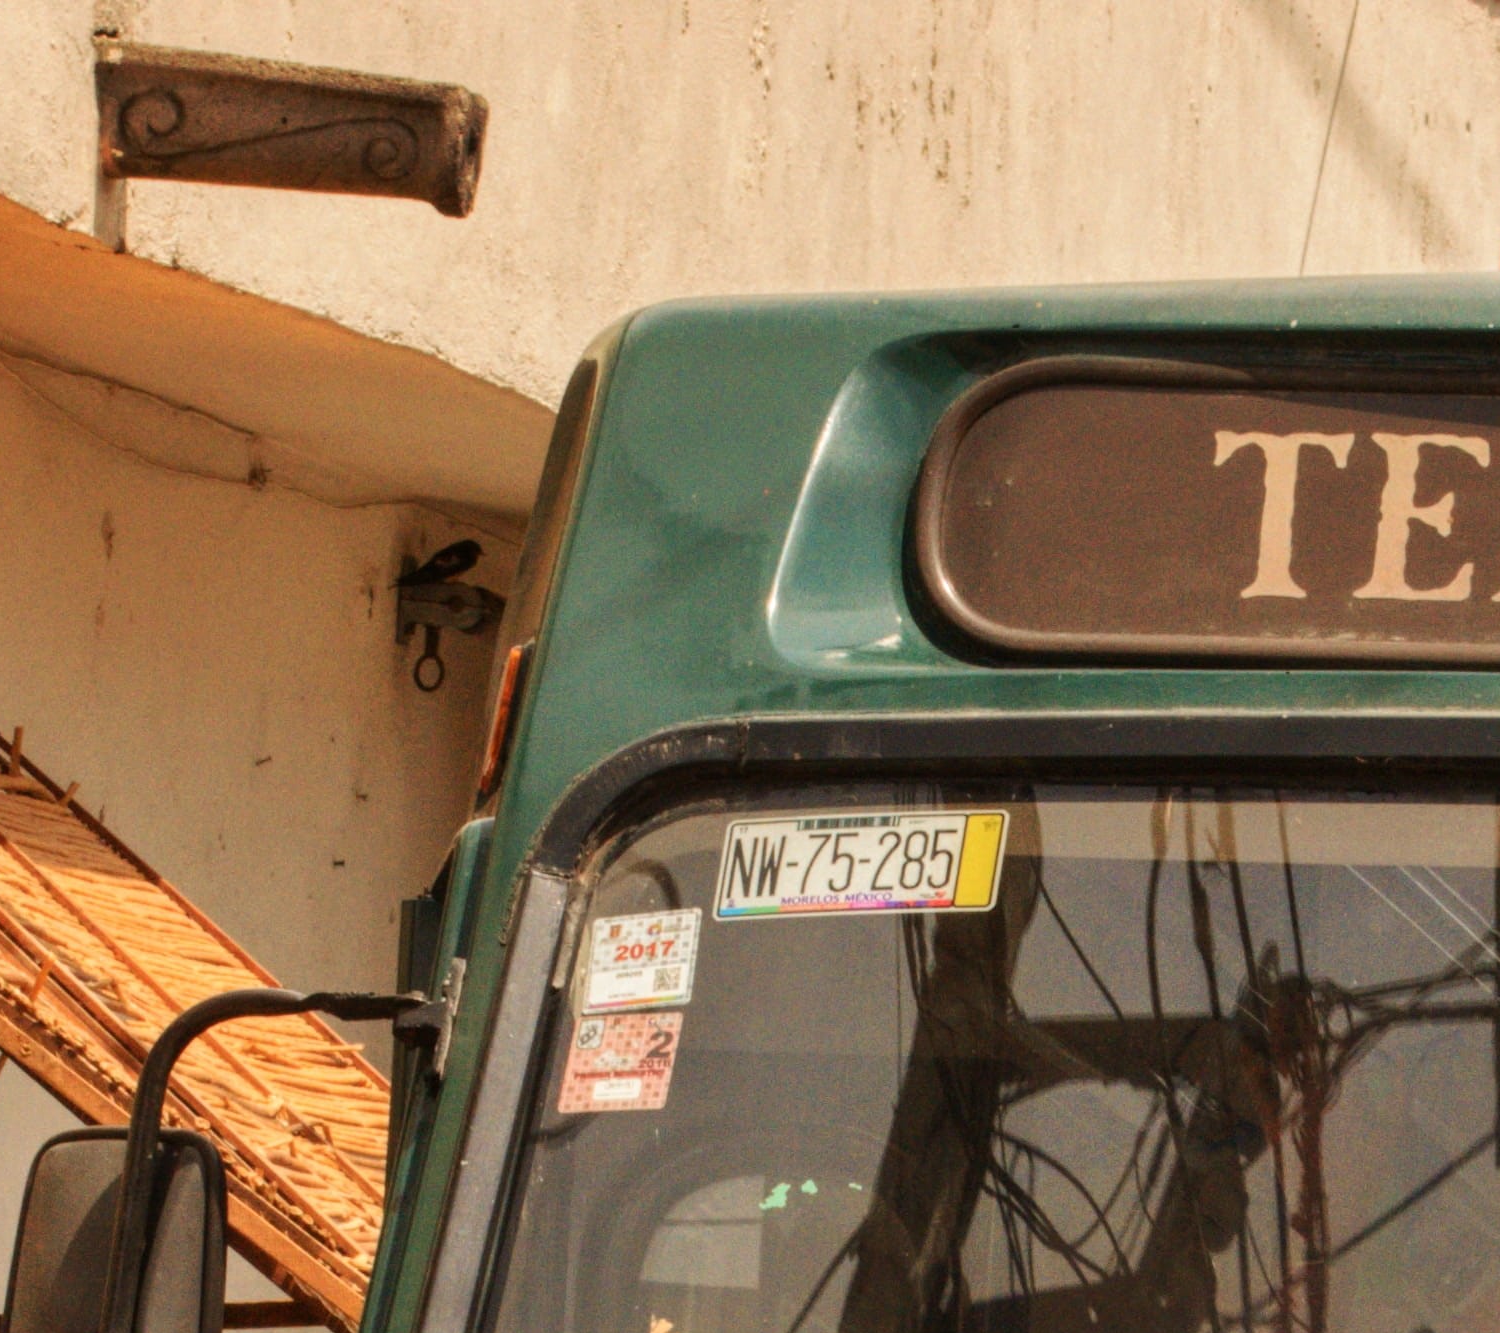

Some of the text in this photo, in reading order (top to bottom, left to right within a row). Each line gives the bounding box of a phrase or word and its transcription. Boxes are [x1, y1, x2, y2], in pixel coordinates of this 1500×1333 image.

[726, 828, 959, 899] NW-75-285
[781, 891, 893, 905] MORELOS MÉXICO
[613, 939, 675, 963] 2017
[645, 1031, 674, 1059] 2
